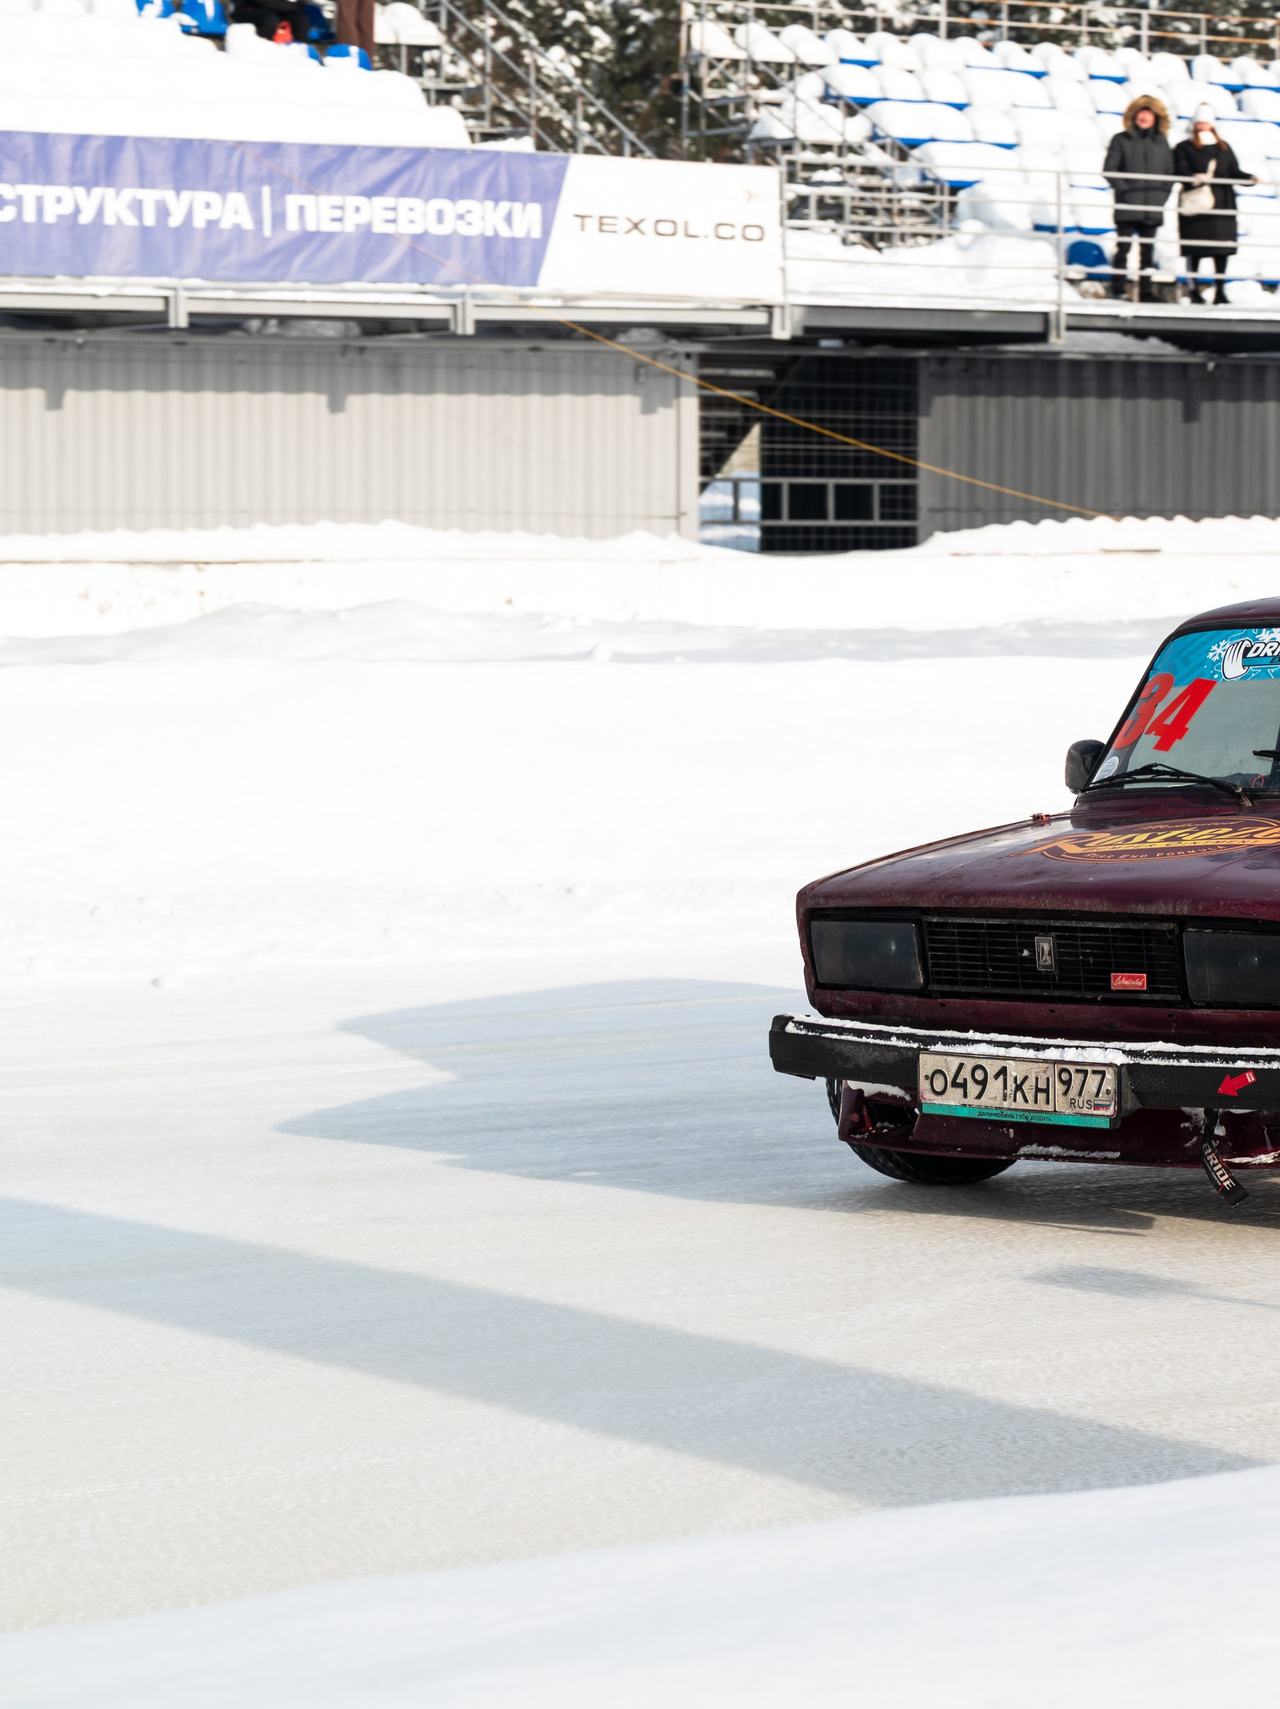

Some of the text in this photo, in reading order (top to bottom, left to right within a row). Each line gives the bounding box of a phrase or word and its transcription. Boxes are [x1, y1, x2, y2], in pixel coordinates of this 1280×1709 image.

[285, 194, 542, 239] ПЕРЕВОЗКИ
[573, 214, 765, 242] TEXOL.CO
[1113, 673, 1218, 752] 34
[1058, 1067, 1107, 1098] 977
[1069, 1098, 1093, 1110] RUS
[1202, 1141, 1236, 1191] BRIDE
